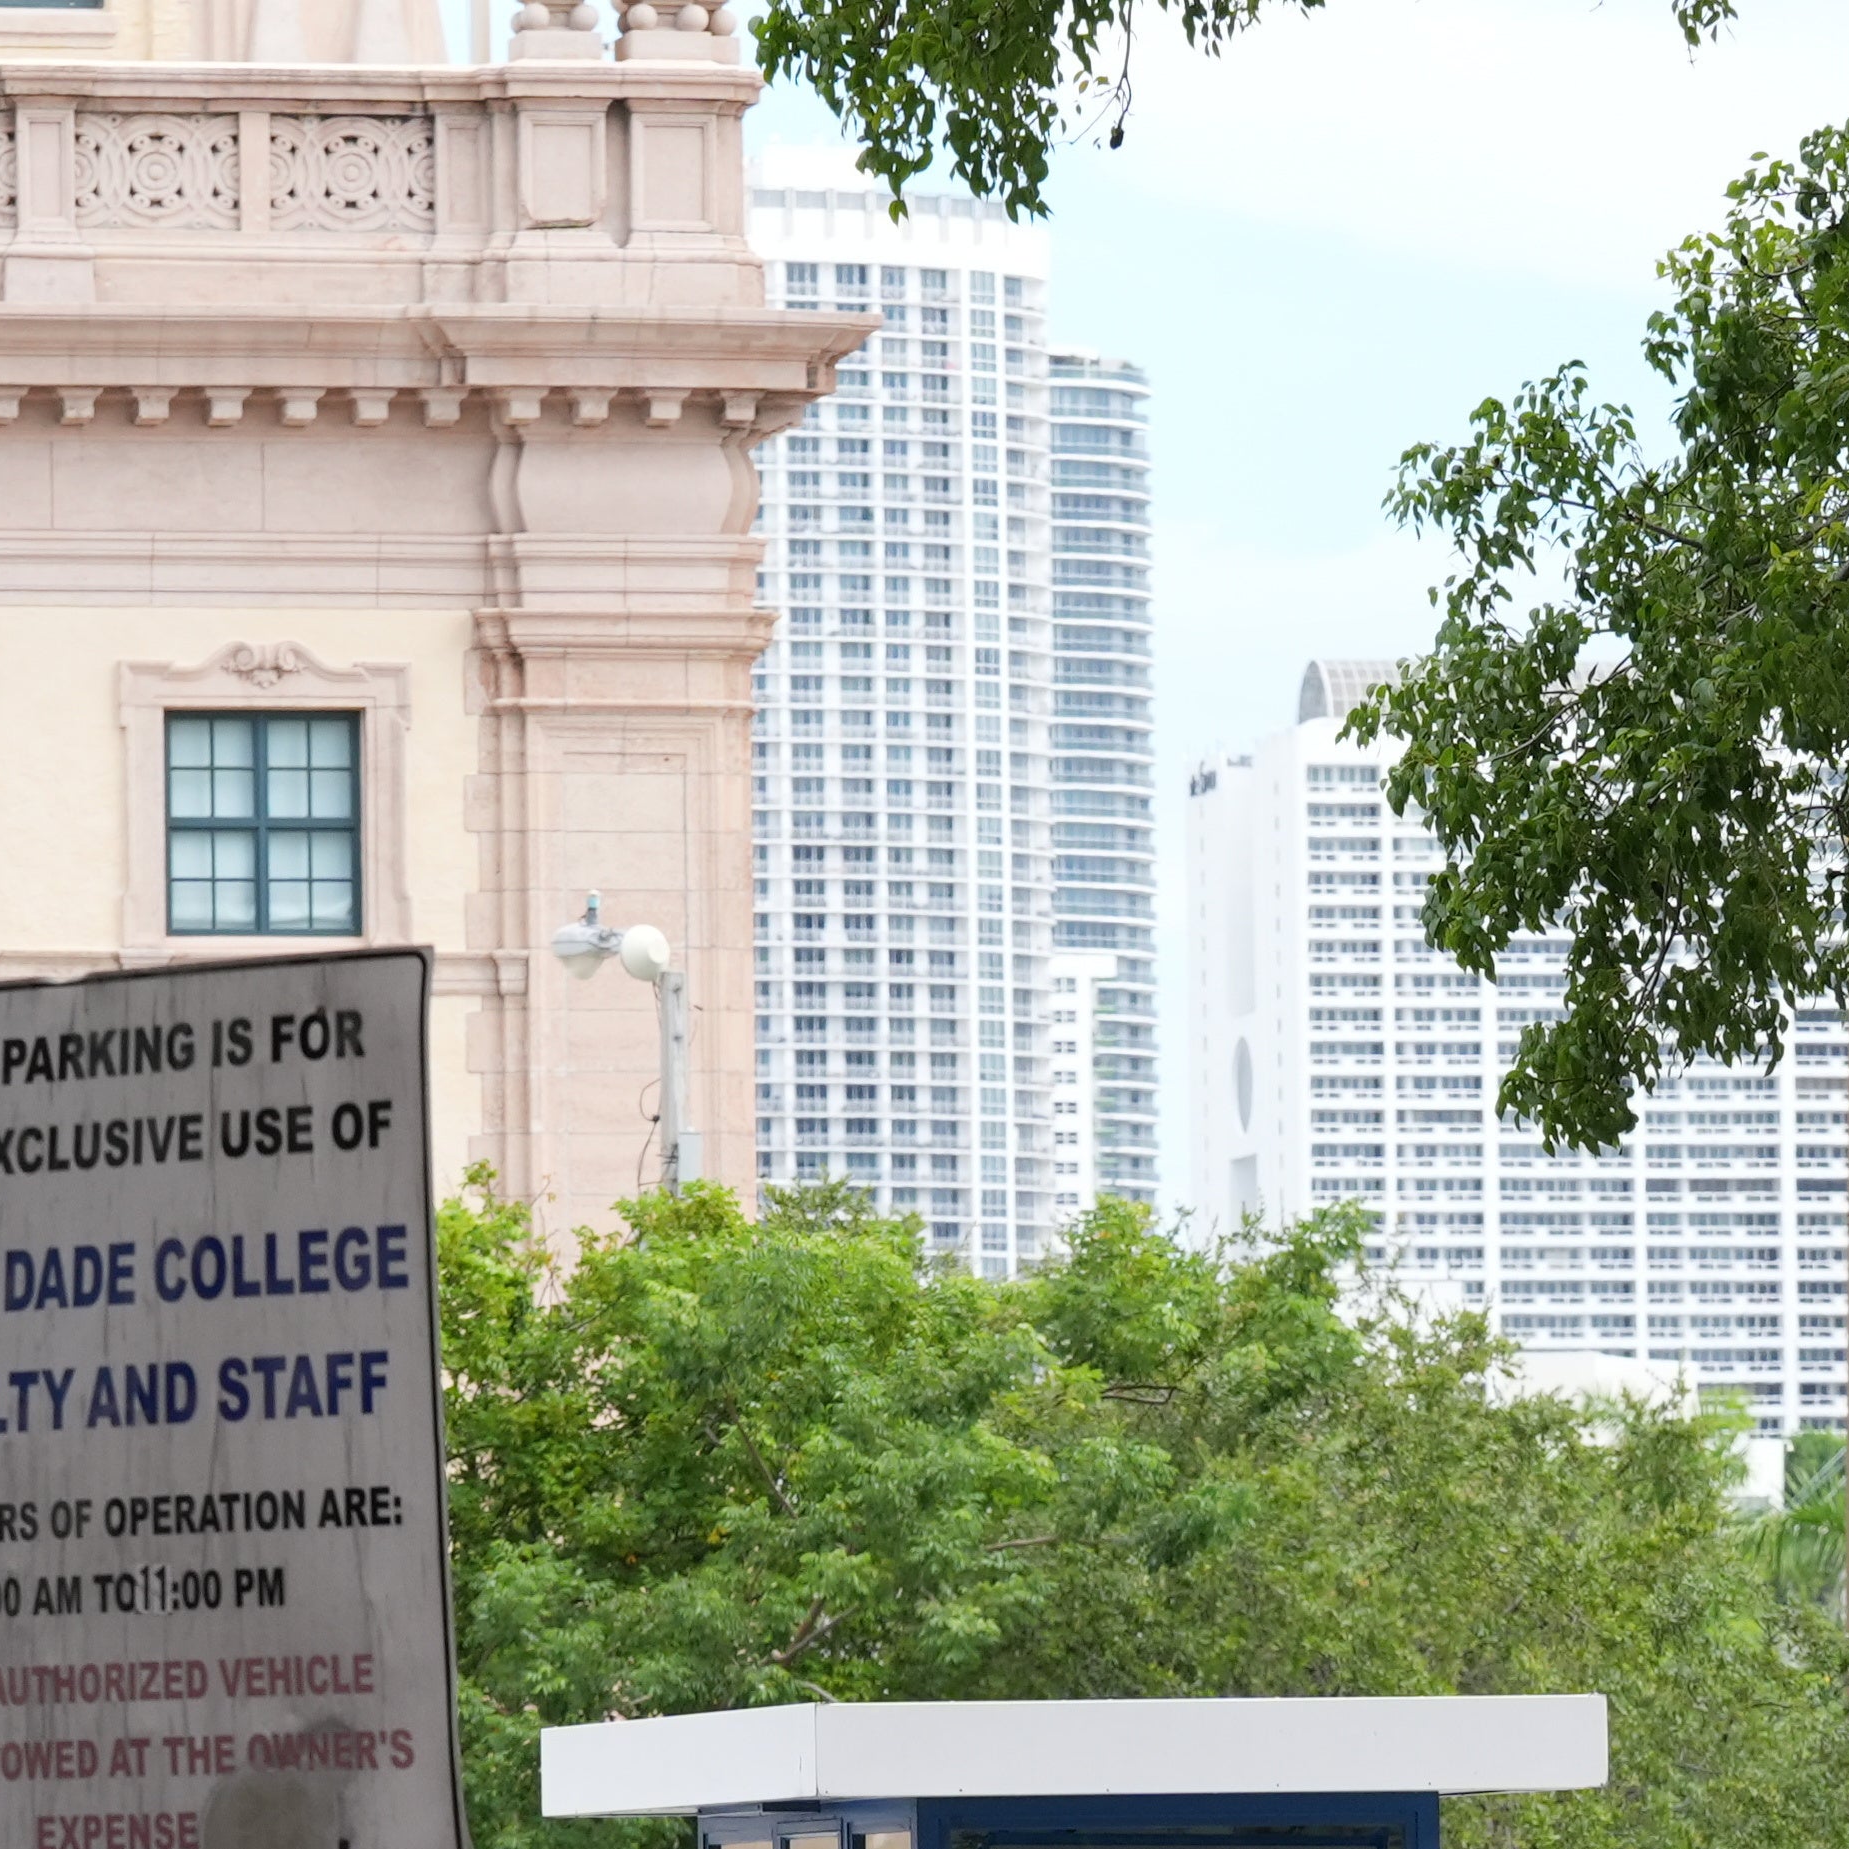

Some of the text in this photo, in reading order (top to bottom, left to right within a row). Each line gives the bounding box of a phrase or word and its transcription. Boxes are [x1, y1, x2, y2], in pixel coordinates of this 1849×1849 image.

[2, 1023, 195, 1086] PARKING
[211, 1017, 252, 1067] IS
[270, 1008, 365, 1062] FOR
[221, 1105, 313, 1157] USE
[331, 1100, 392, 1151] OF
[4, 1242, 135, 1312] DADE
[155, 1224, 408, 1303] COLLEGE
[86, 1360, 197, 1428] AND
[218, 1351, 389, 1424] STAFF
[52, 1498, 92, 1540] OF
[104, 1489, 306, 1538] OPERATION
[317, 1486, 403, 1529] ARE:
[33, 1575, 82, 1616] AM
[93, 1573, 135, 1614] TO
[138, 1566, 221, 1613] 11:00
[234, 1567, 285, 1609] PM
[218, 1653, 374, 1698] VEHICLE
[108, 1738, 150, 1779] AT
[163, 1735, 235, 1776] THE
[246, 1729, 414, 1771] OWNER'S
